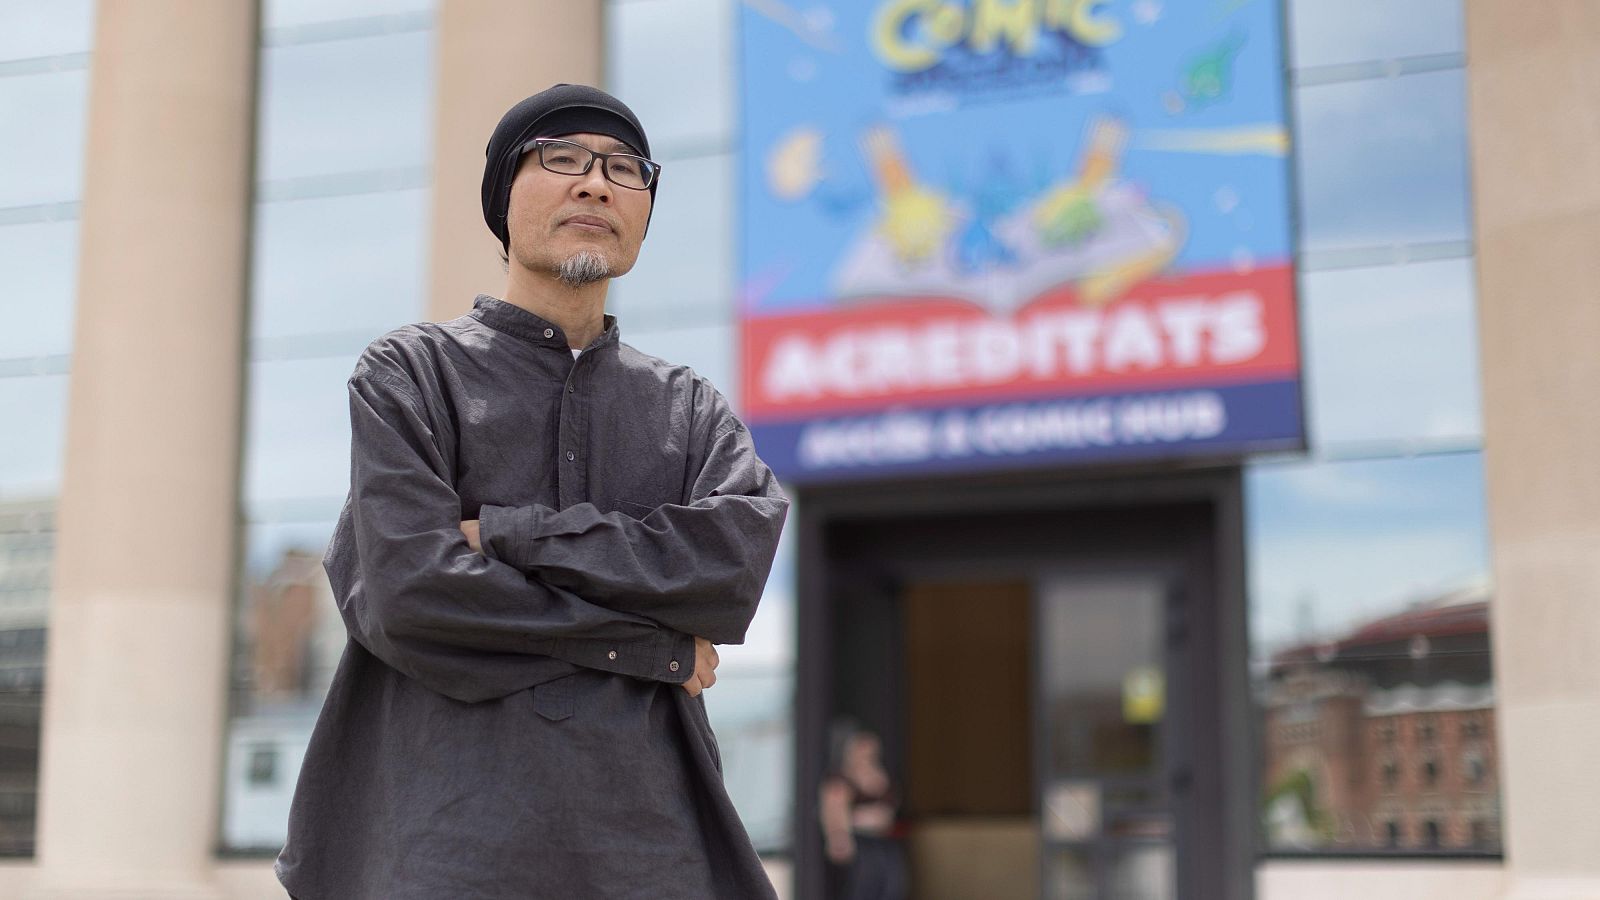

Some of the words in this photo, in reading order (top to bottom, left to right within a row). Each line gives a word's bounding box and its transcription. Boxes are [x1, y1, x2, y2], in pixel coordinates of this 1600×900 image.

[764, 295, 1266, 400] ACREDITATS
[976, 400, 1115, 454] COMIC
[1120, 390, 1225, 441] HUB
